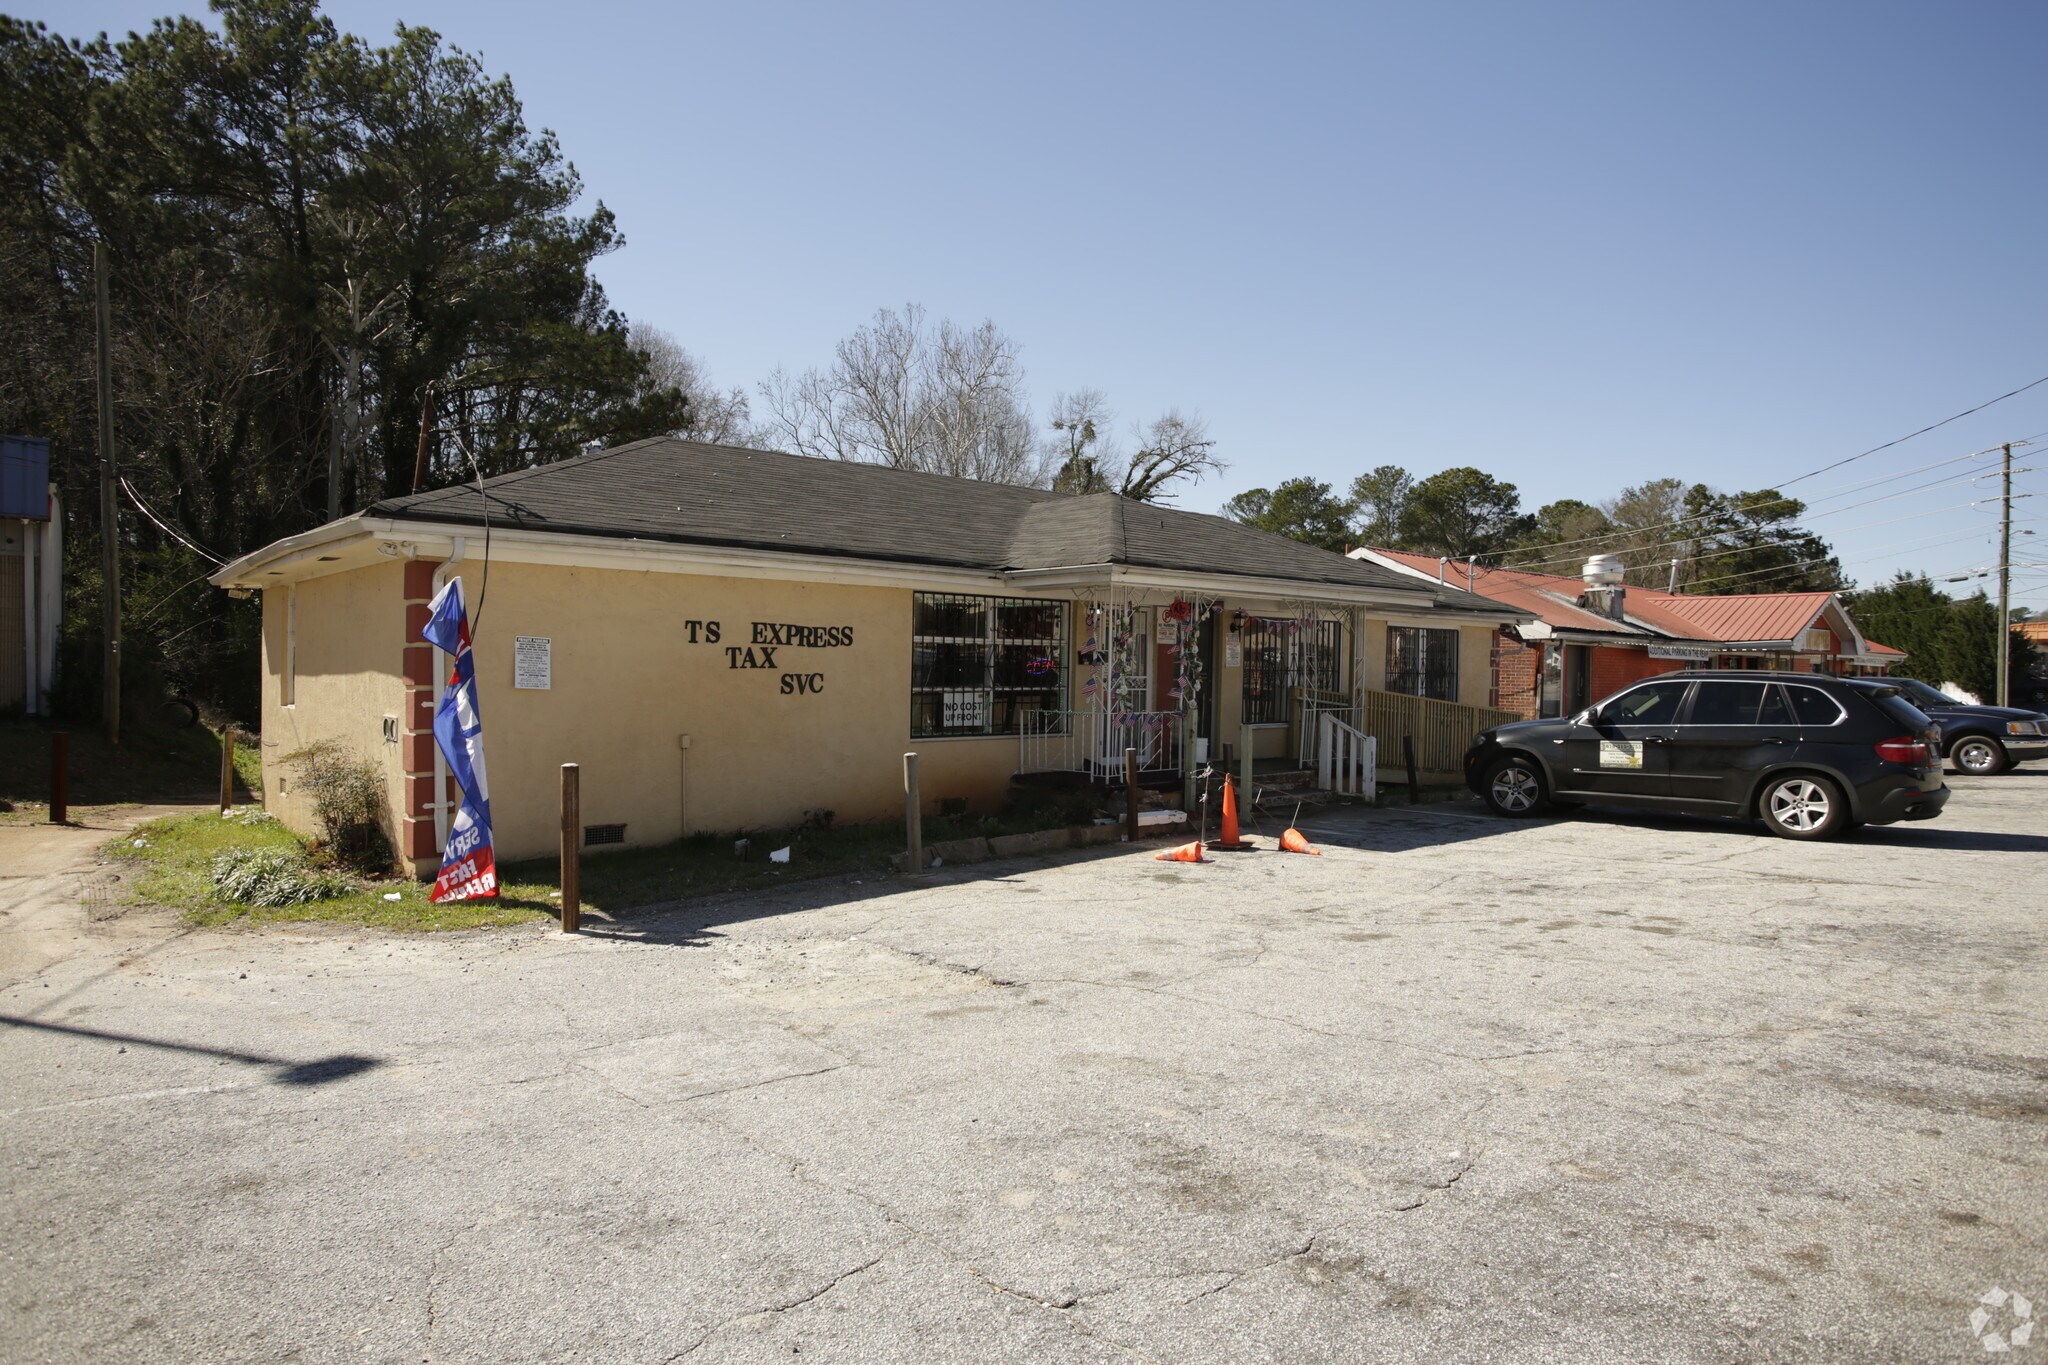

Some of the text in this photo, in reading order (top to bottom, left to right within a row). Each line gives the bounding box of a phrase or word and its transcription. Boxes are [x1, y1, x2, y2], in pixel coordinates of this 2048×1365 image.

[685, 620, 853, 647] TS EXPRESS
[726, 647, 777, 669] TAX
[780, 673, 824, 695] SVC
[945, 702, 983, 711] NO COST
[945, 713, 983, 721] UP FRONT
